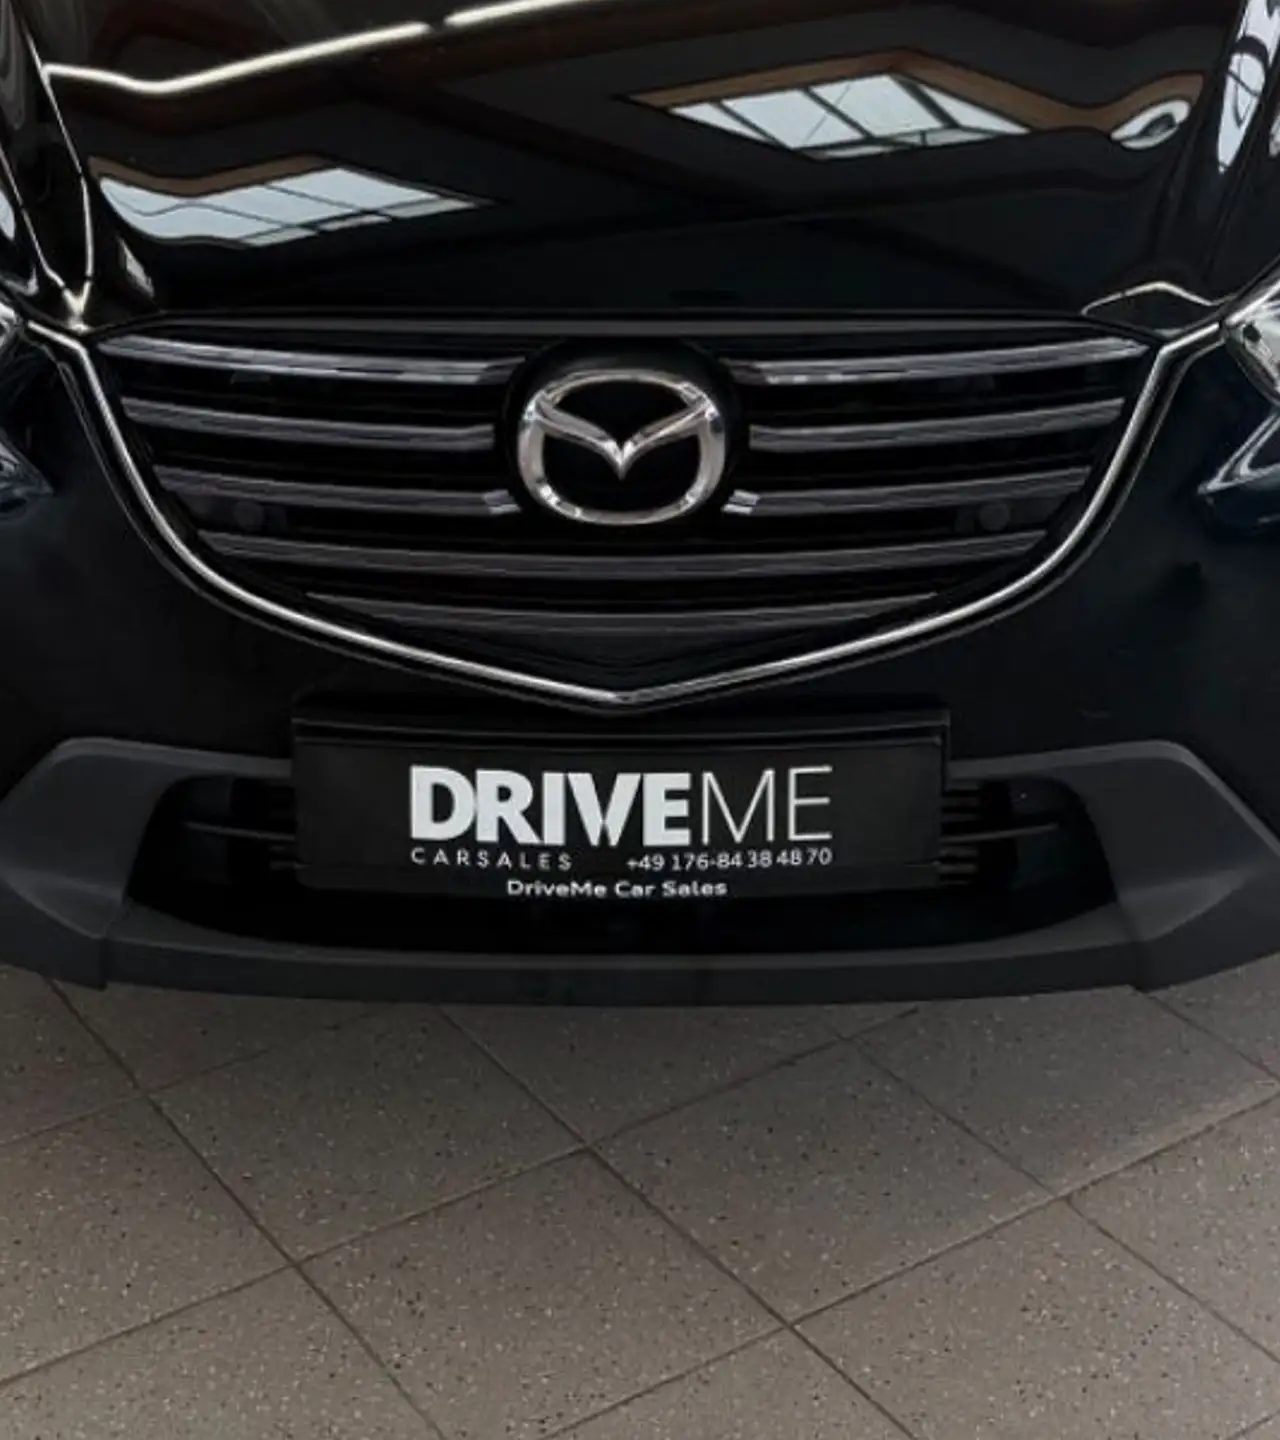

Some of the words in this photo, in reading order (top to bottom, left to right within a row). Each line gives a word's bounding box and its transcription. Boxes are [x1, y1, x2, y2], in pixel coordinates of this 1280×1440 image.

[410, 765, 833, 846] DRIVEME
[410, 847, 573, 872] CARSALES
[626, 853, 665, 872] +49
[507, 879, 608, 898] DriveMe
[614, 880, 657, 899] Car
[661, 879, 728, 898] Sales
